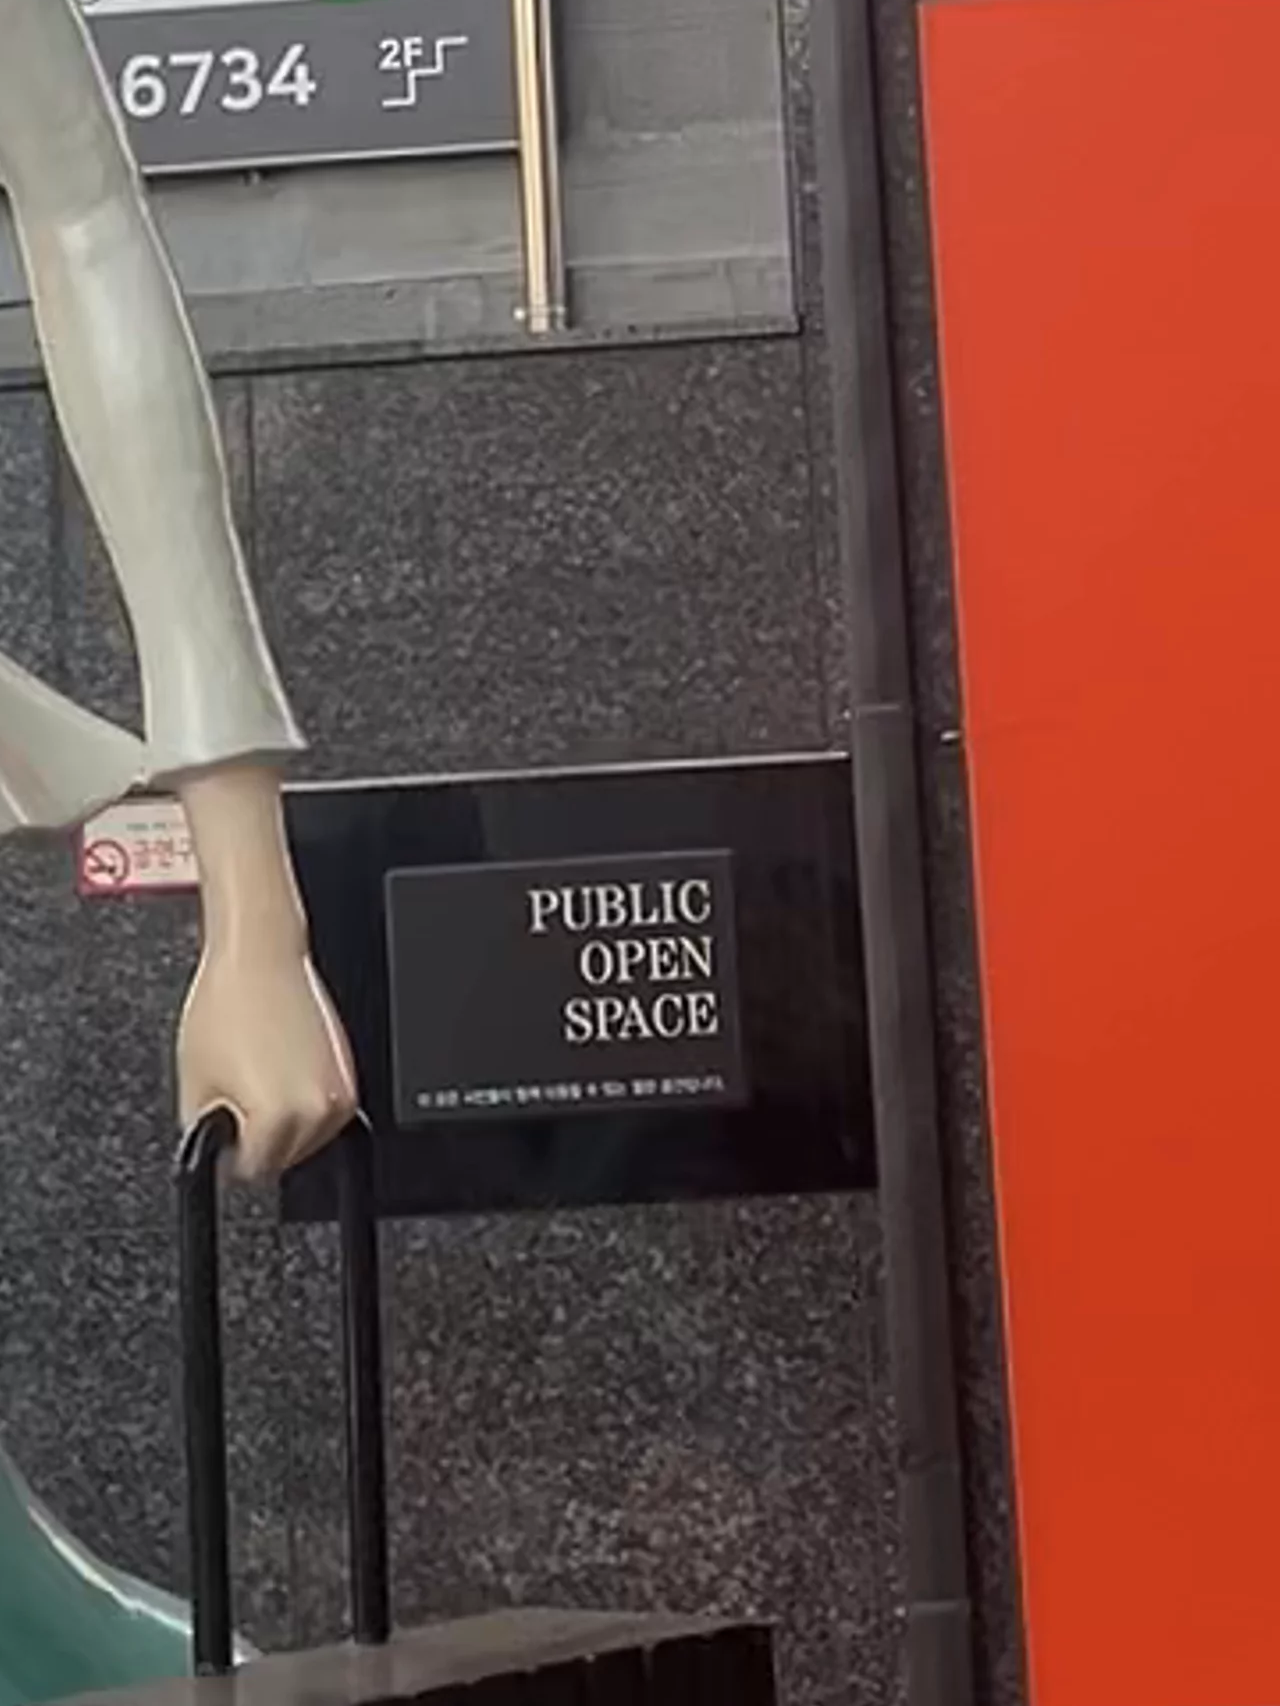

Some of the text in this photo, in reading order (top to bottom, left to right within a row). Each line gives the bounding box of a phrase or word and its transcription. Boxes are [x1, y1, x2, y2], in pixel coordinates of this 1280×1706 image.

[378, 35, 424, 71] 2F
[527, 878, 712, 934] PUBLIC
[580, 936, 714, 986] OPEN
[564, 990, 719, 1043] SPACE
